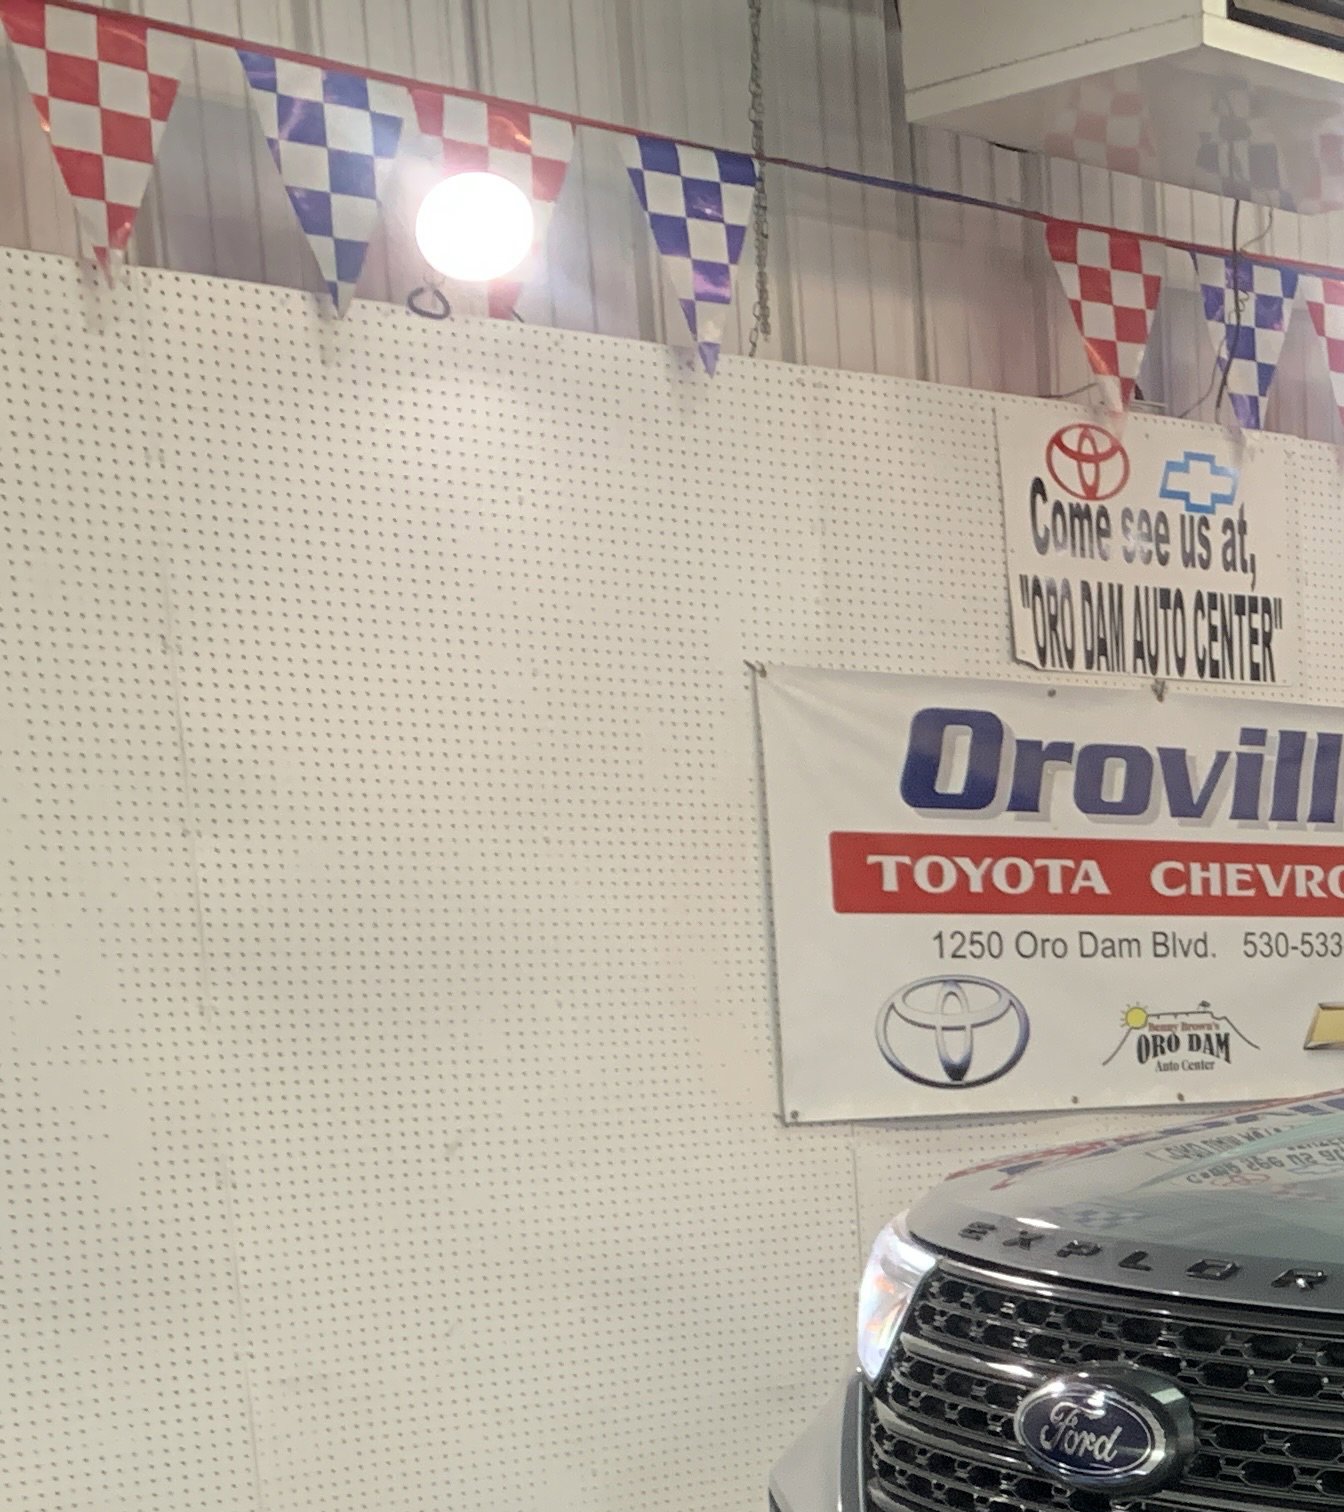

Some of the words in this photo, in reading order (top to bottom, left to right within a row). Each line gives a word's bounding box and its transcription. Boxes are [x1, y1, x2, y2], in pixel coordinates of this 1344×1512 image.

[1030, 476, 1111, 561] Come
[1121, 507, 1170, 566] see
[1180, 514, 1212, 570] us
[1222, 502, 1256, 592] at,
[1019, 574, 1075, 670] "ORO
[1081, 580, 1126, 673] DAM
[1133, 585, 1186, 677] AUTO
[1194, 589, 1282, 682] CENTER"
[866, 854, 1111, 895] TOYOTA
[932, 931, 1003, 959] 1250
[1015, 931, 1068, 959] Oro
[1079, 931, 1142, 959] Dam
[1152, 931, 1217, 959] Blvd.
[1136, 1033, 1180, 1064] ORO
[1187, 1032, 1231, 1064] DAM
[1156, 1060, 1179, 1072] Auto
[1181, 1059, 1216, 1072] Center
[1040, 1400, 1122, 1466] Ford
